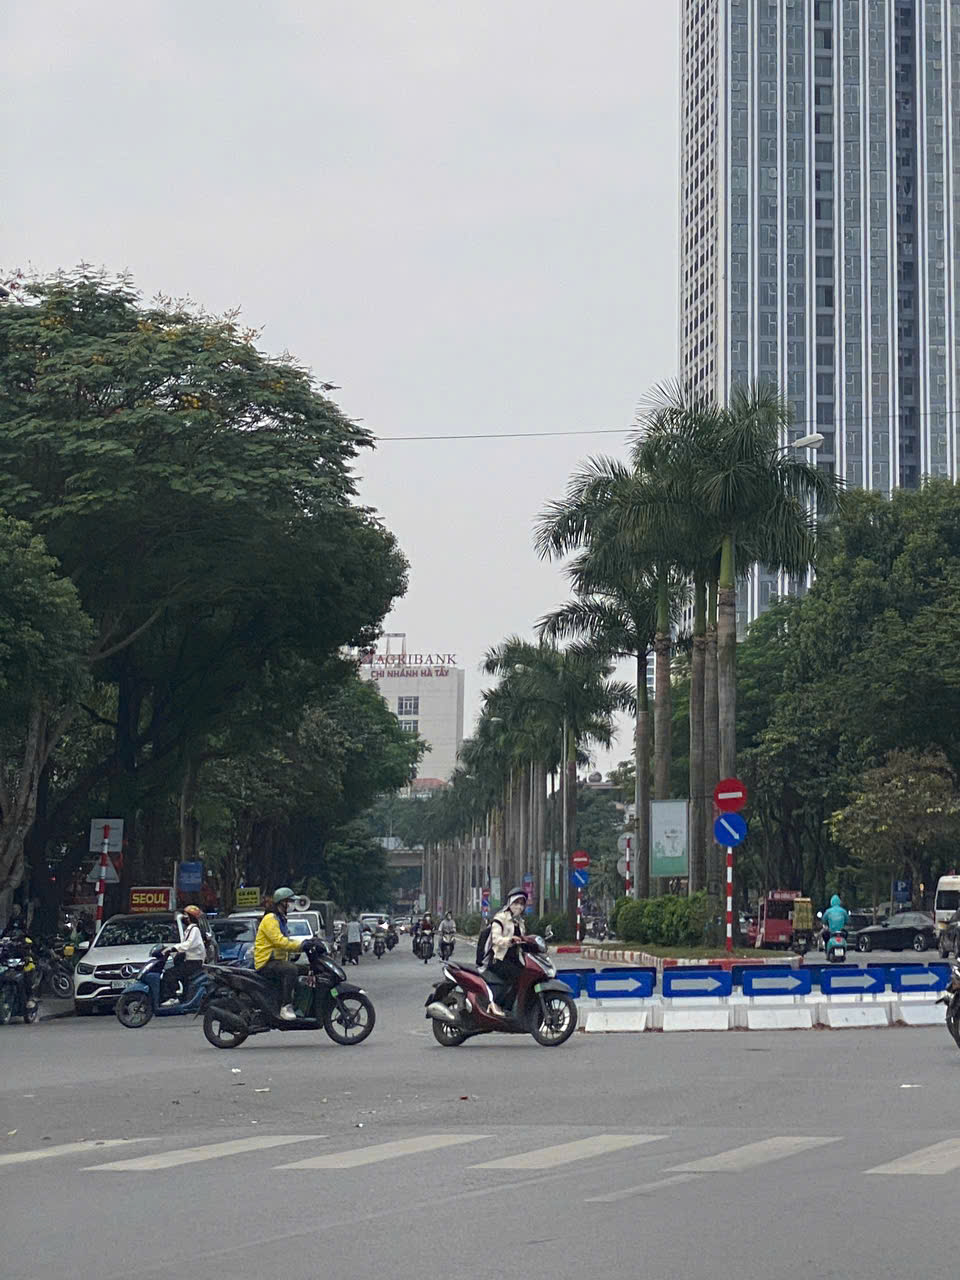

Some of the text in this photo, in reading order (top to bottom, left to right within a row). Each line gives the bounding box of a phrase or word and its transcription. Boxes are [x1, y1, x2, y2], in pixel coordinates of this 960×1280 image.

[375, 653, 457, 665] AGRIBANK
[371, 666, 449, 678] CHI NHÁNH HÀ TÂY
[897, 880, 906, 891] P
[132, 893, 167, 904] SEOUL
